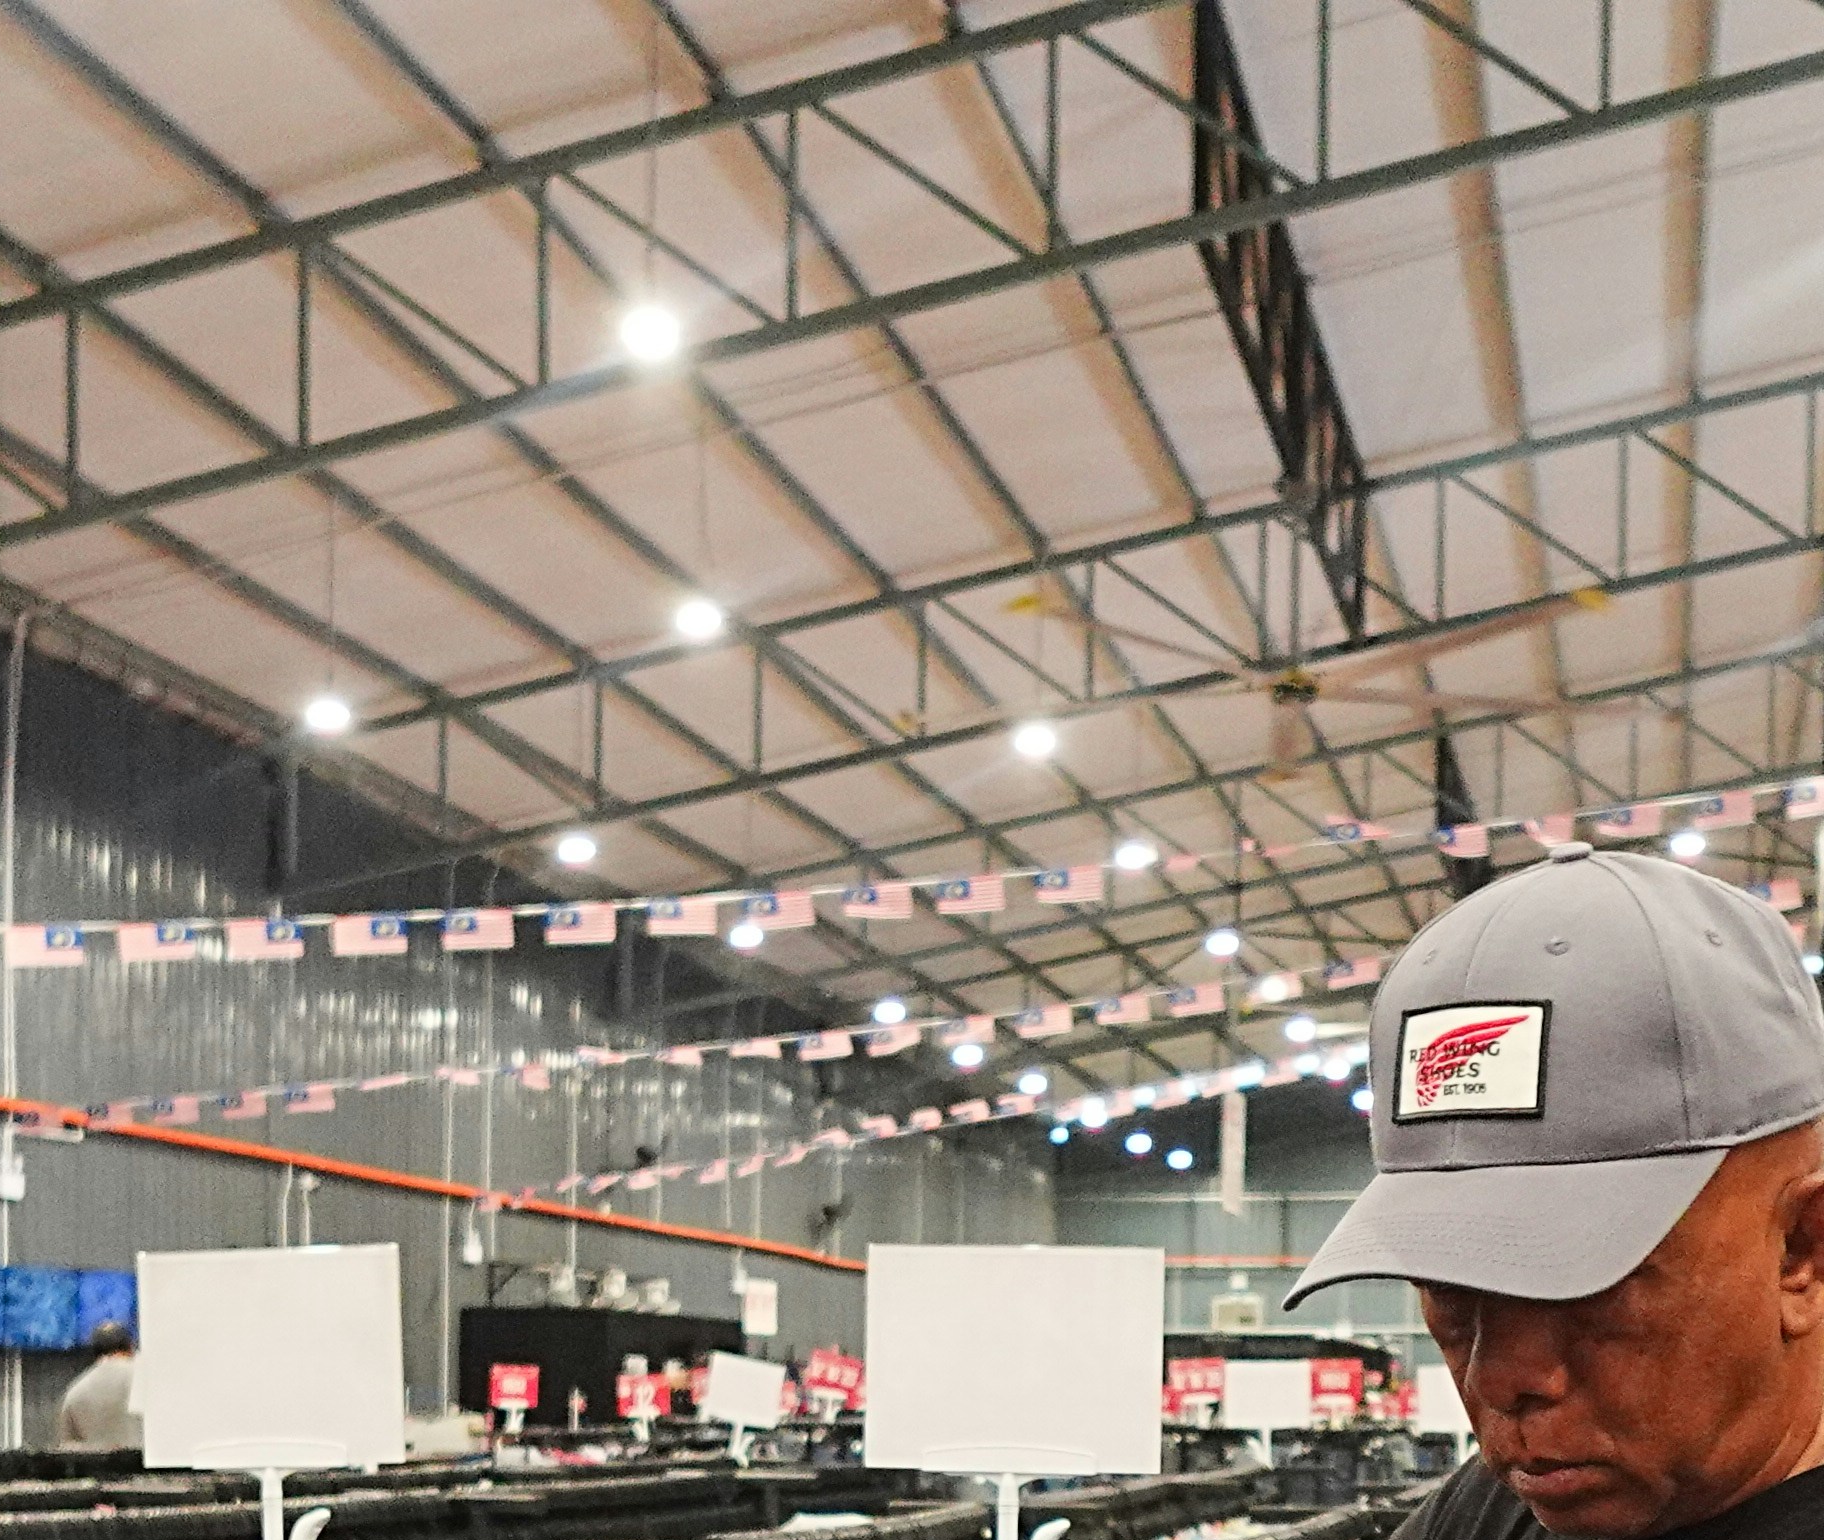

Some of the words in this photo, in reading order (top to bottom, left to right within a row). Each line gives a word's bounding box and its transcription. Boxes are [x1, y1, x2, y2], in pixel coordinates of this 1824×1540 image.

[1409, 1045, 1437, 1064] RED
[1442, 1041, 1500, 1058] WING
[1419, 1062, 1480, 1082] SHOES
